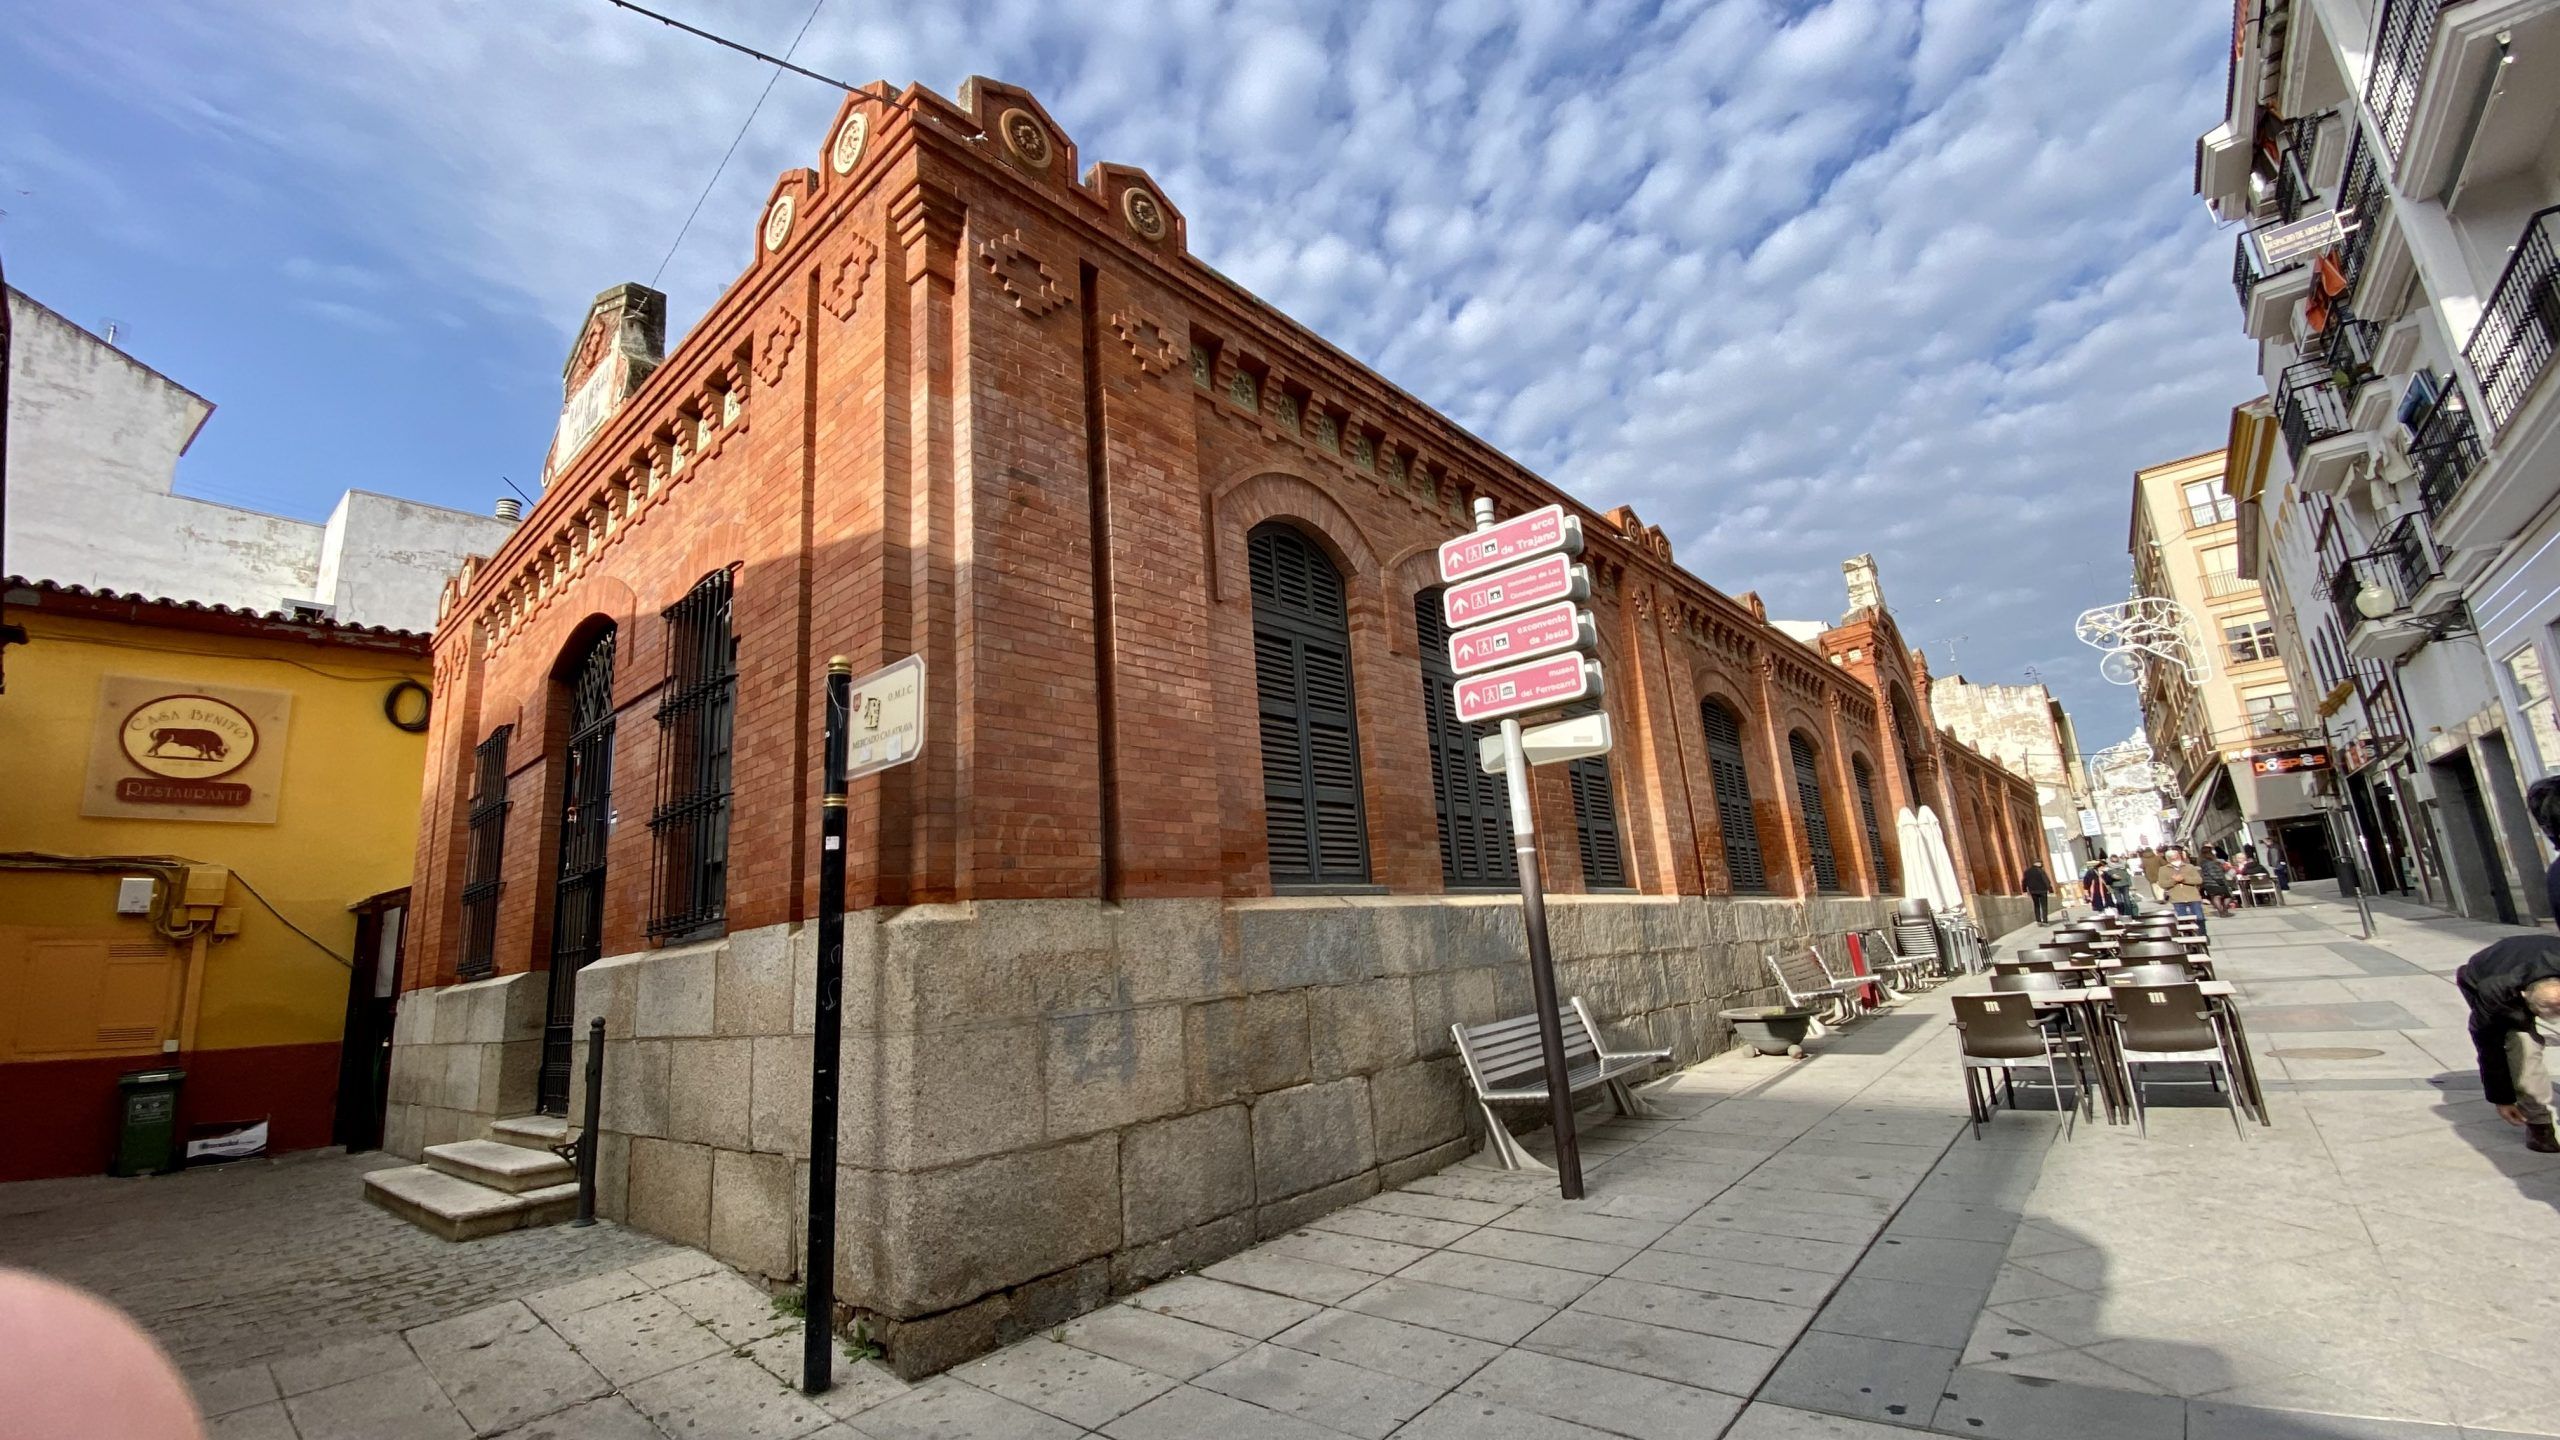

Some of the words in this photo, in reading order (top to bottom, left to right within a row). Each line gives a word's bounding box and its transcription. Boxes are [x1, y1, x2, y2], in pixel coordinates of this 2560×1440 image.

[1530, 516, 1555, 531] arco
[1501, 545, 1514, 555] de
[1516, 531, 1557, 550] Trajano
[1517, 614, 1567, 634] exconvento
[1544, 628, 1569, 641] Jesús
[1548, 665, 1575, 677] museo
[1520, 688, 1533, 698] del
[1536, 678, 1577, 695] Ferrocarril
[126, 782, 244, 801] RESTAURANTE
